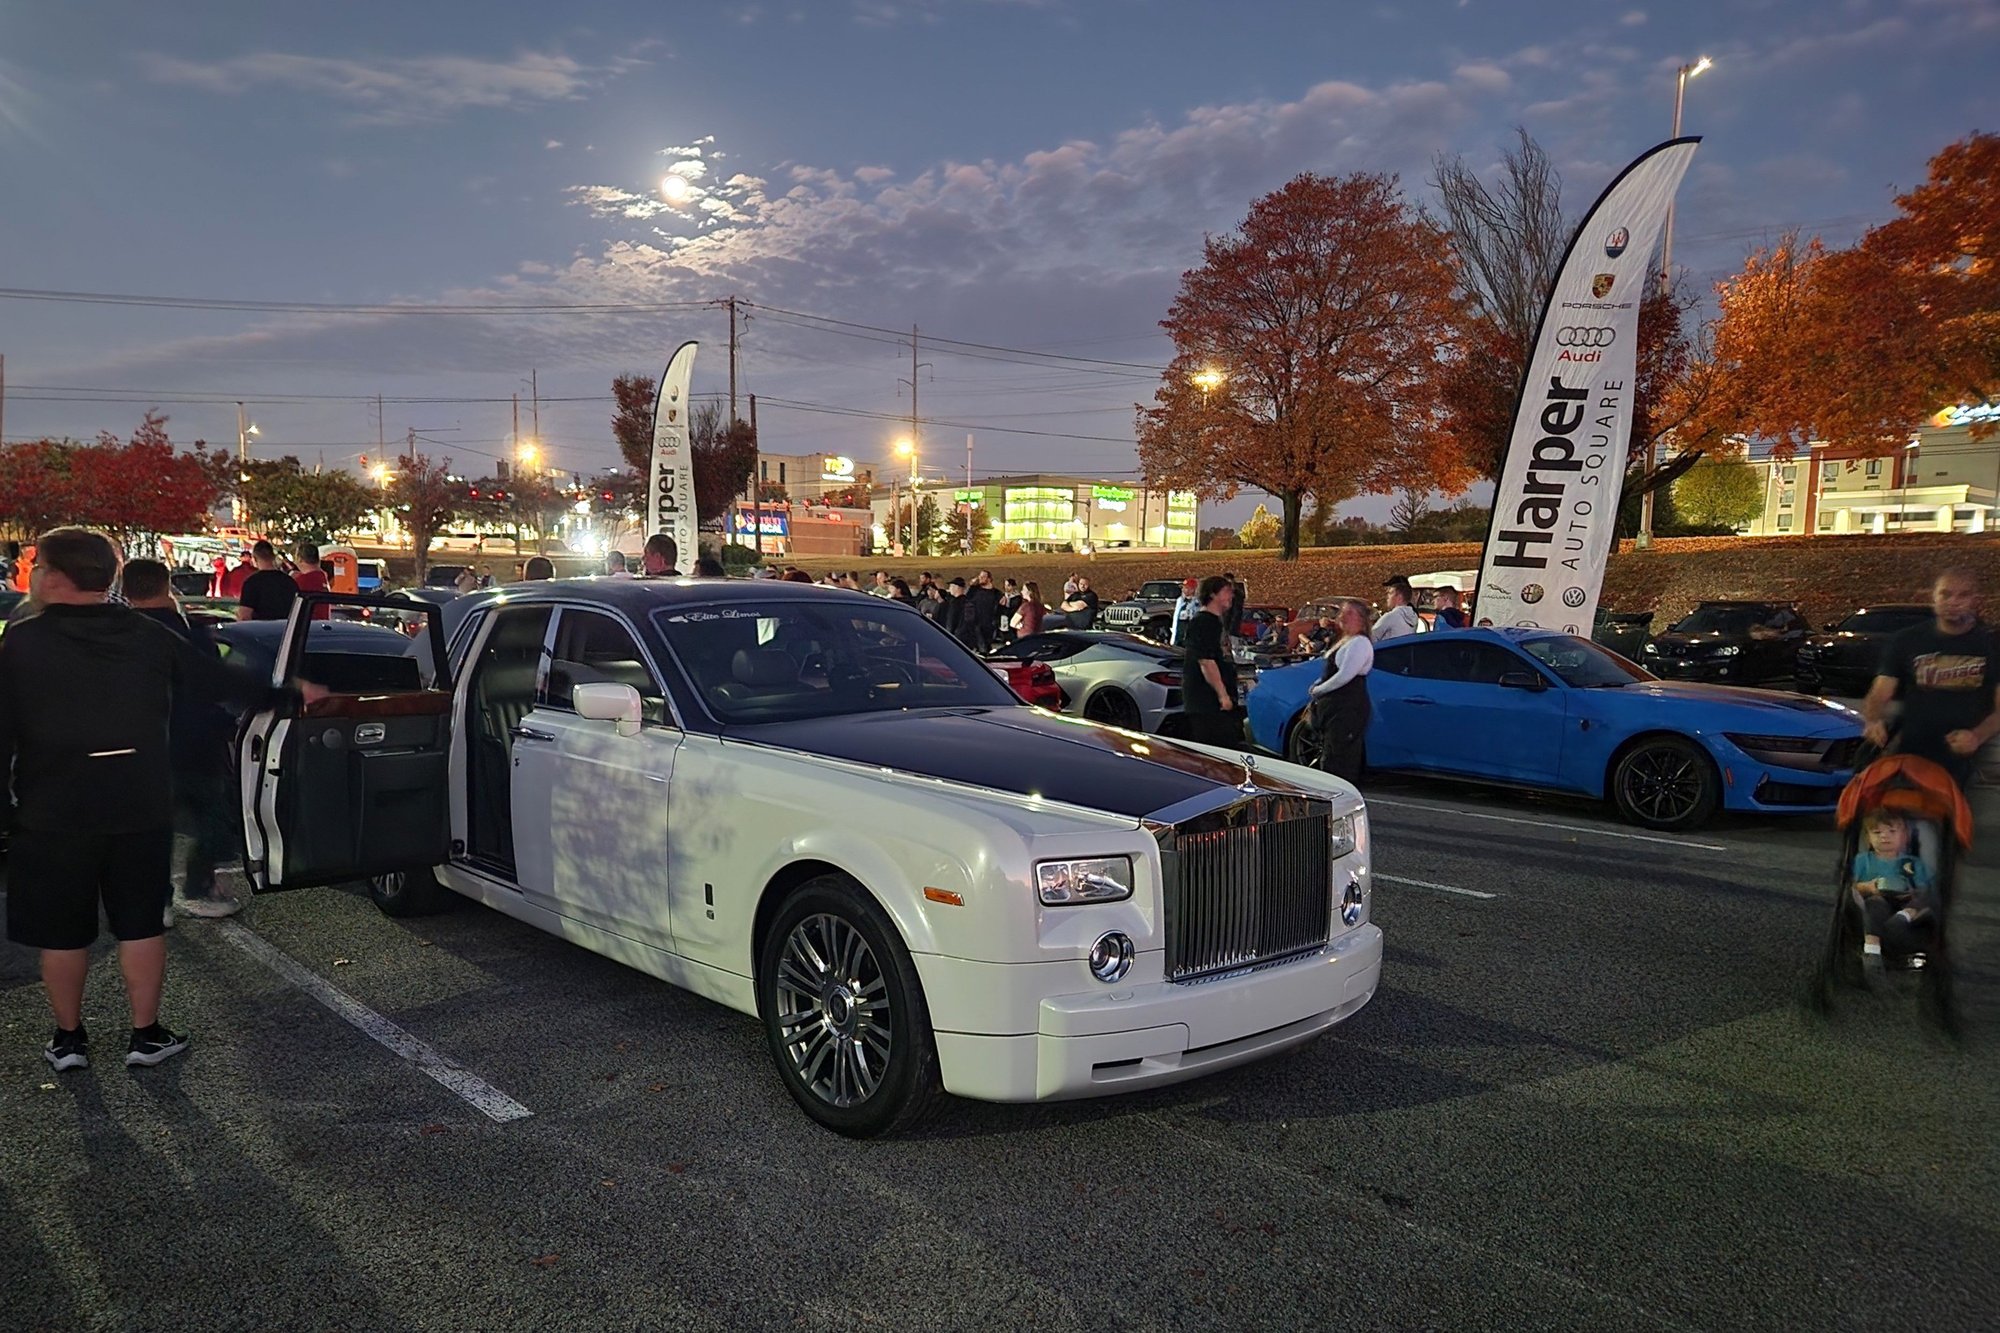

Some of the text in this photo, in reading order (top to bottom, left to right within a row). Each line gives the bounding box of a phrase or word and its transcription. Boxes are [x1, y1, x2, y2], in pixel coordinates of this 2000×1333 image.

[1558, 350, 1602, 362] Audi
[658, 463, 679, 538] arper
[679, 464, 689, 566] AUTO SQUARE
[1493, 376, 1589, 569] Harper
[1561, 380, 1623, 570] AUTO SQUARE
